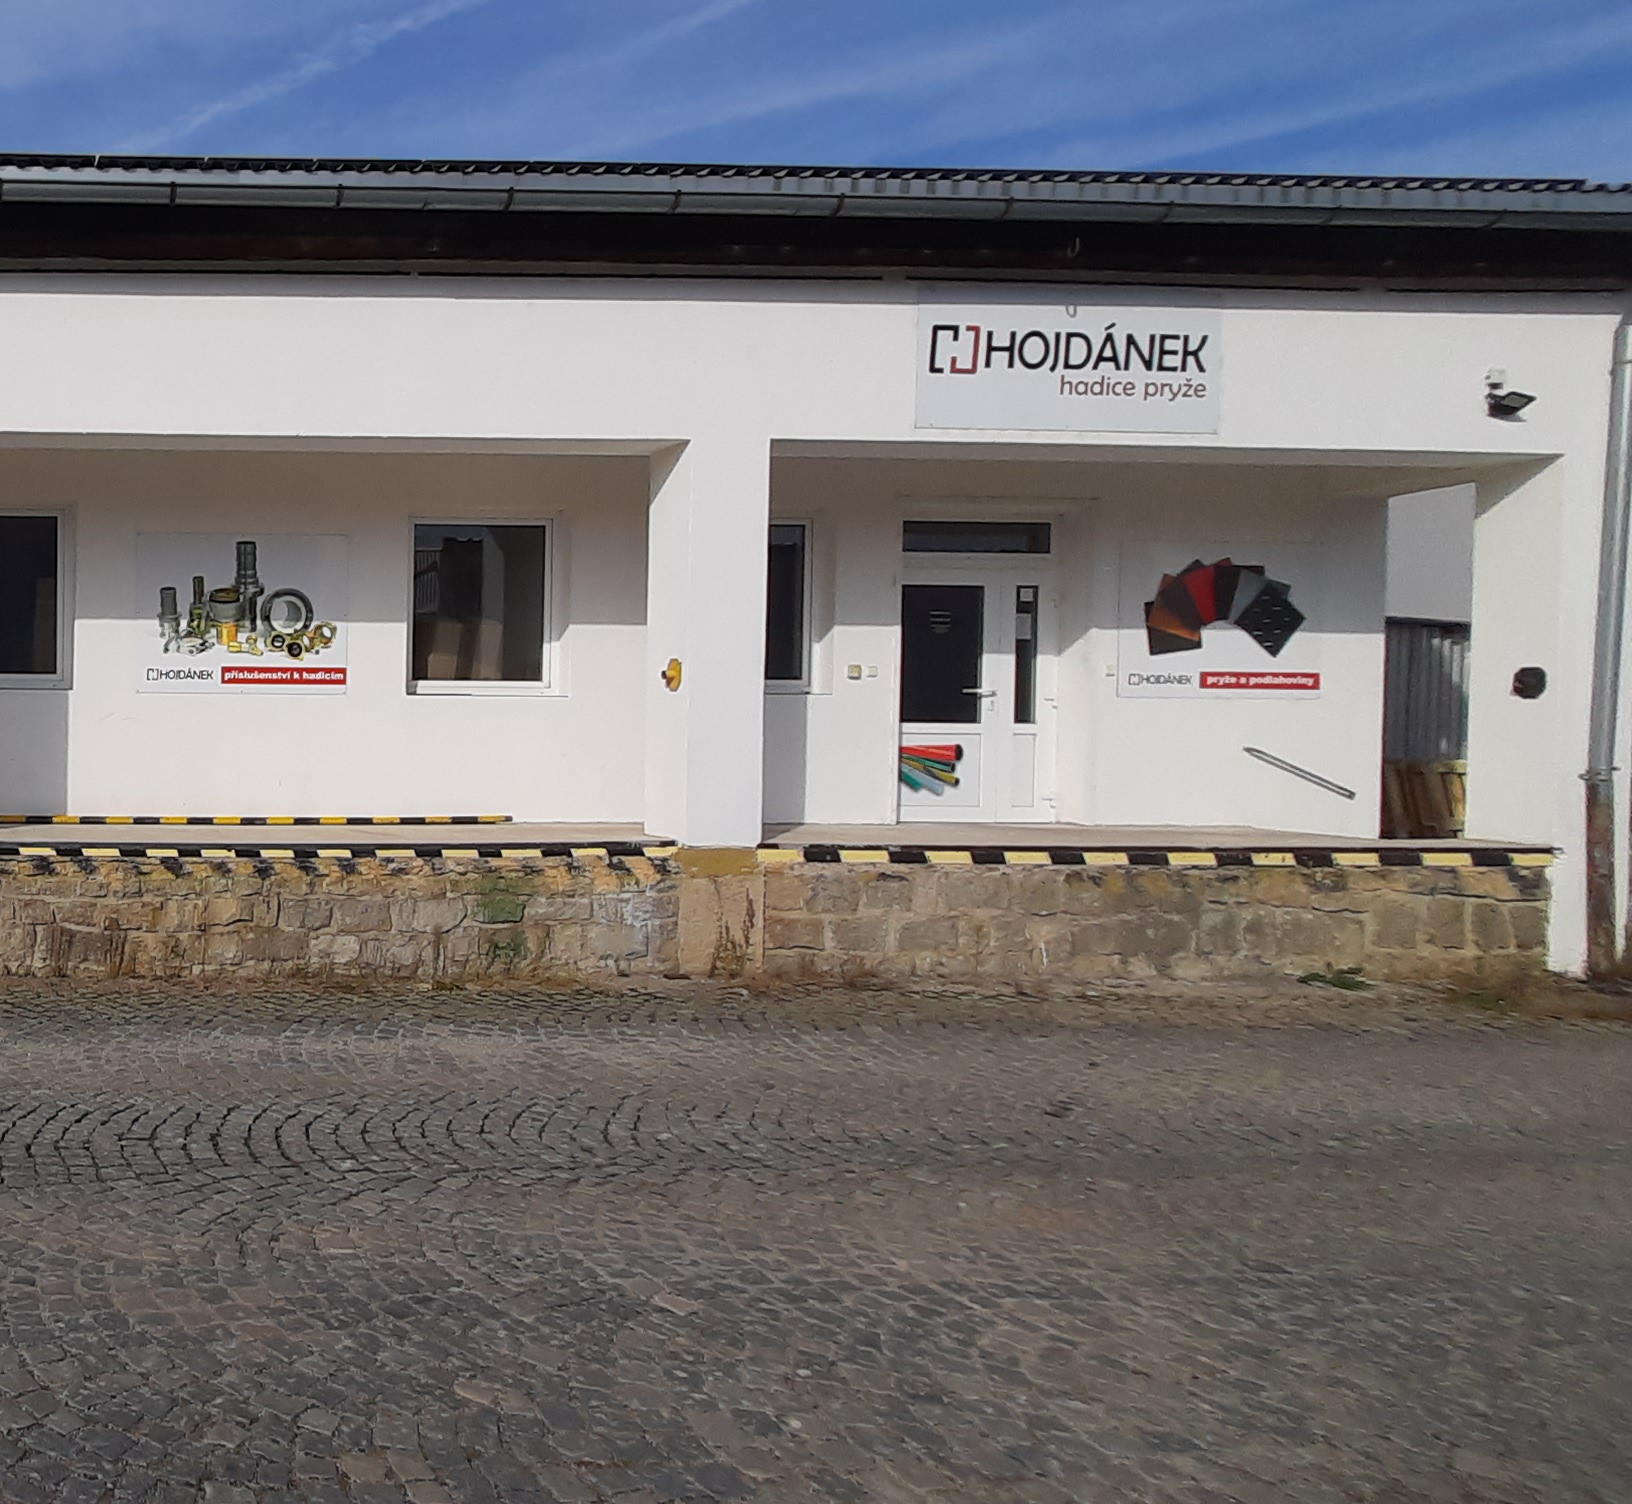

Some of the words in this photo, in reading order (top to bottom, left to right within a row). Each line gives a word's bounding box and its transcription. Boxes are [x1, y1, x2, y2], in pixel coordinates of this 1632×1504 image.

[984, 322, 1209, 373] HOJDÁNEK
[1059, 375, 1136, 397] hadice
[1143, 378, 1207, 401] pryže
[159, 667, 214, 680] HOJDÁNEK
[224, 670, 291, 681] příslušenství
[293, 671, 300, 680] k
[303, 670, 344, 680] hadicím
[1206, 675, 1237, 685] pryže
[1249, 675, 1315, 686] podlahoviny
